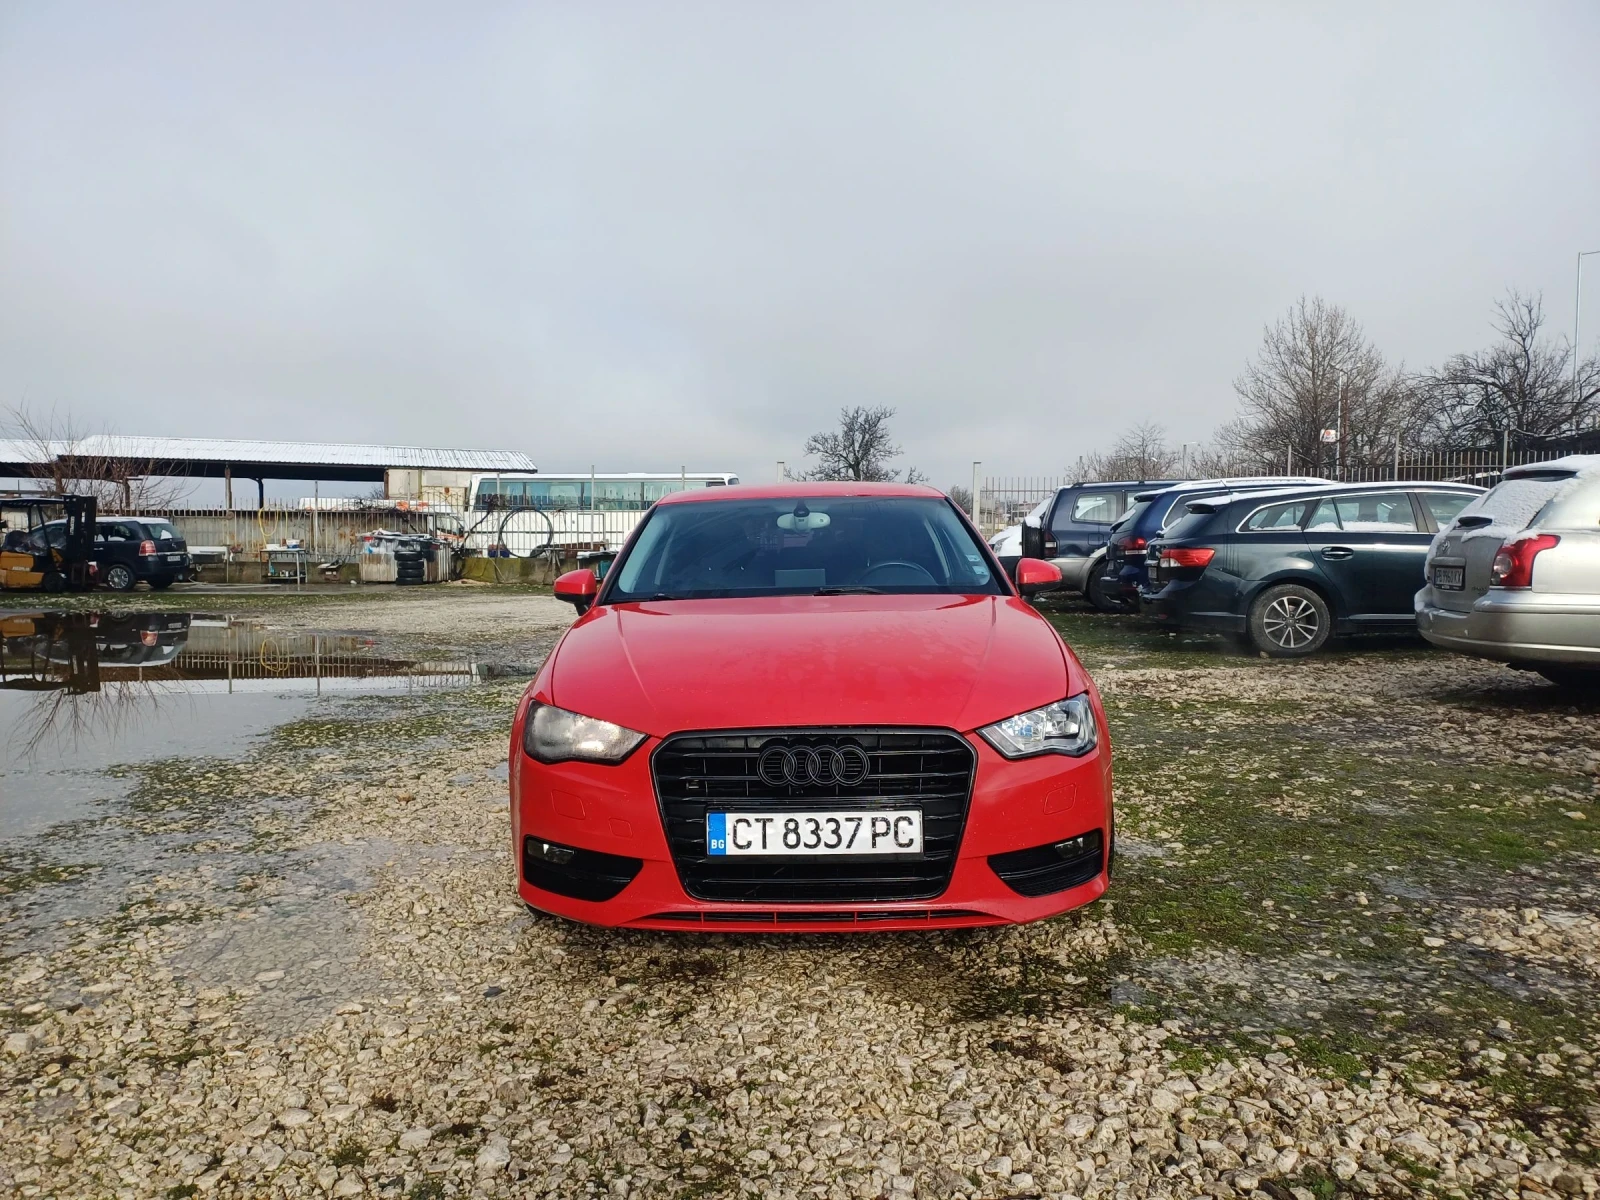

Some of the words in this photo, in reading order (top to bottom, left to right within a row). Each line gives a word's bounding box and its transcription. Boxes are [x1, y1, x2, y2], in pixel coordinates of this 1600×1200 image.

[711, 839, 725, 849] BG
[732, 818, 774, 850] CT
[782, 817, 863, 850] 8337
[871, 816, 914, 849] PC
